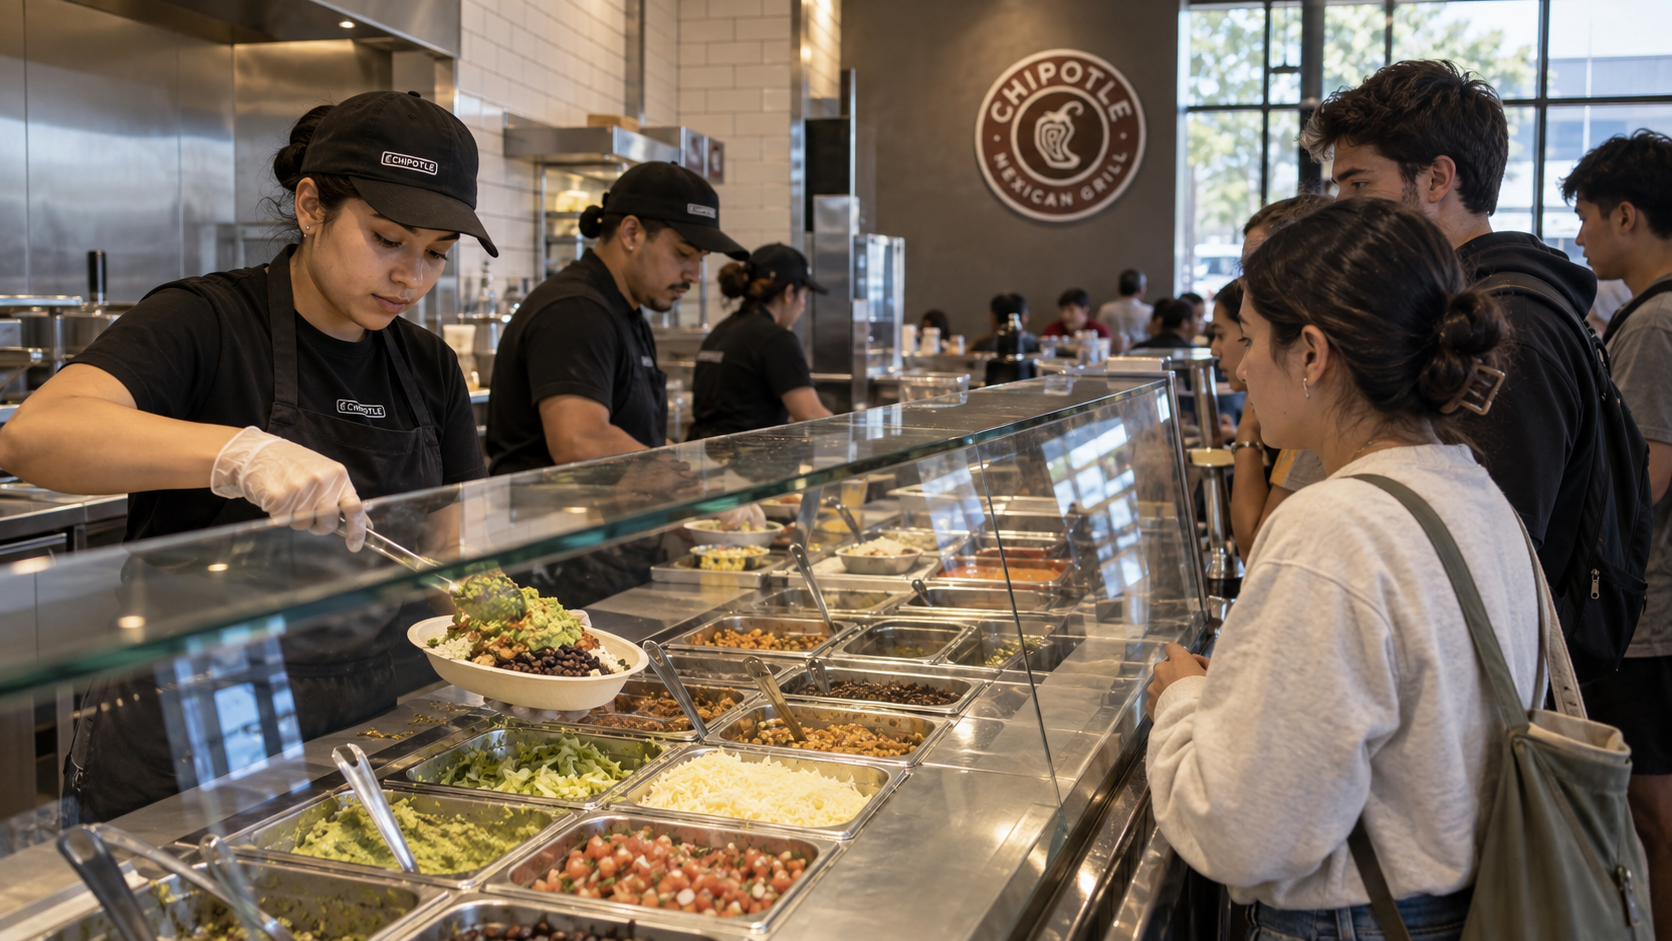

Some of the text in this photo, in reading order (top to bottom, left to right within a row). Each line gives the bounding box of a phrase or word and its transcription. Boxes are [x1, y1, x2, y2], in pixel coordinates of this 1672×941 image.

[991, 60, 1132, 123] CHIPOTLE
[994, 152, 1128, 207] MEXICAN GRILL
